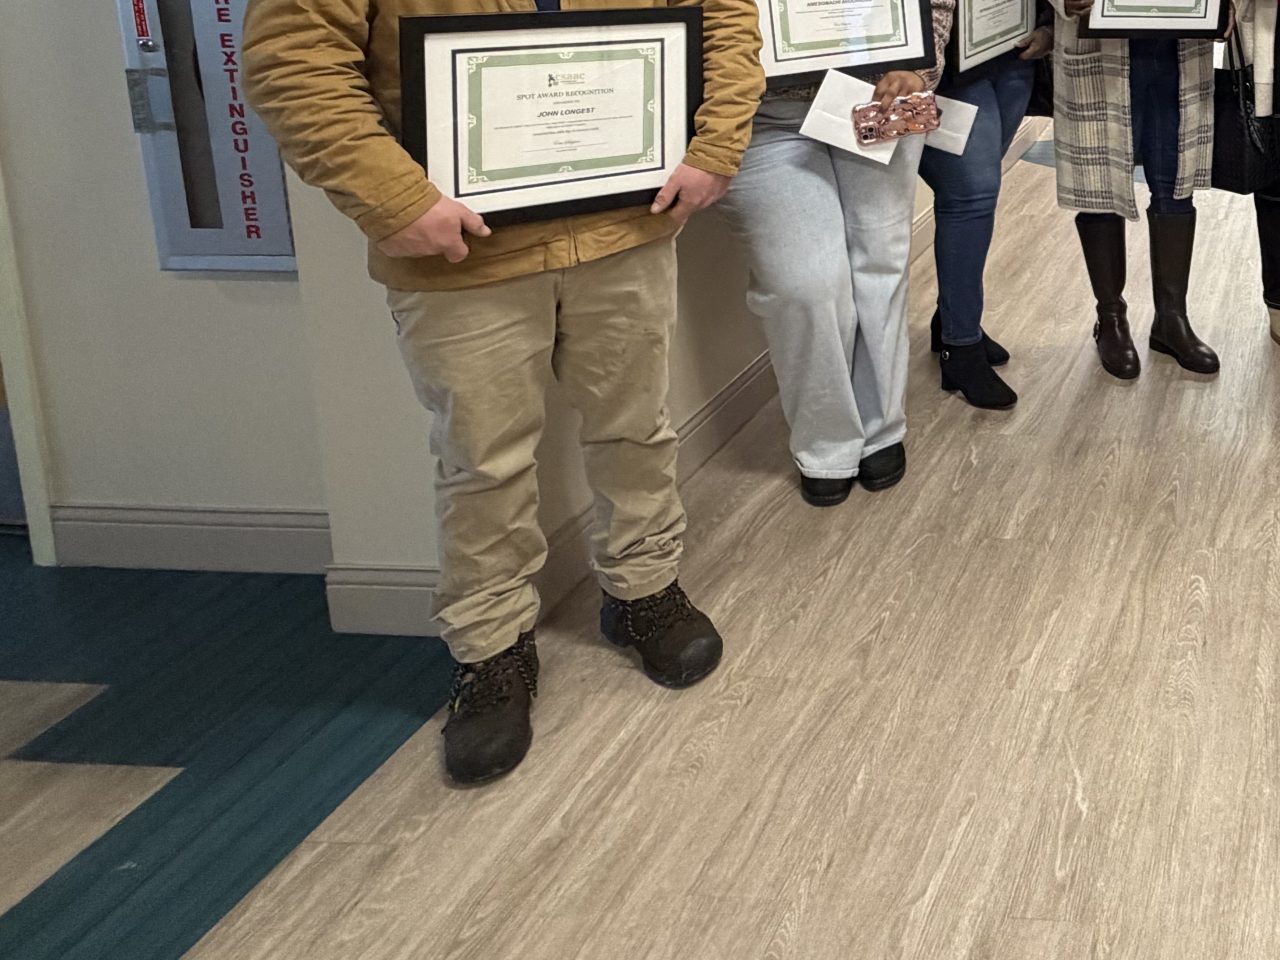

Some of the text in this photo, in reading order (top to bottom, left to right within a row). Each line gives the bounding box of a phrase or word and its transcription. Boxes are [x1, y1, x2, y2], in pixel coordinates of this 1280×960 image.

[516, 87, 614, 101] SPOT AWARD RECOGNITION
[537, 107, 596, 118] JOHN LONGEST
[218, 33, 262, 240] EXTINGUISHER
